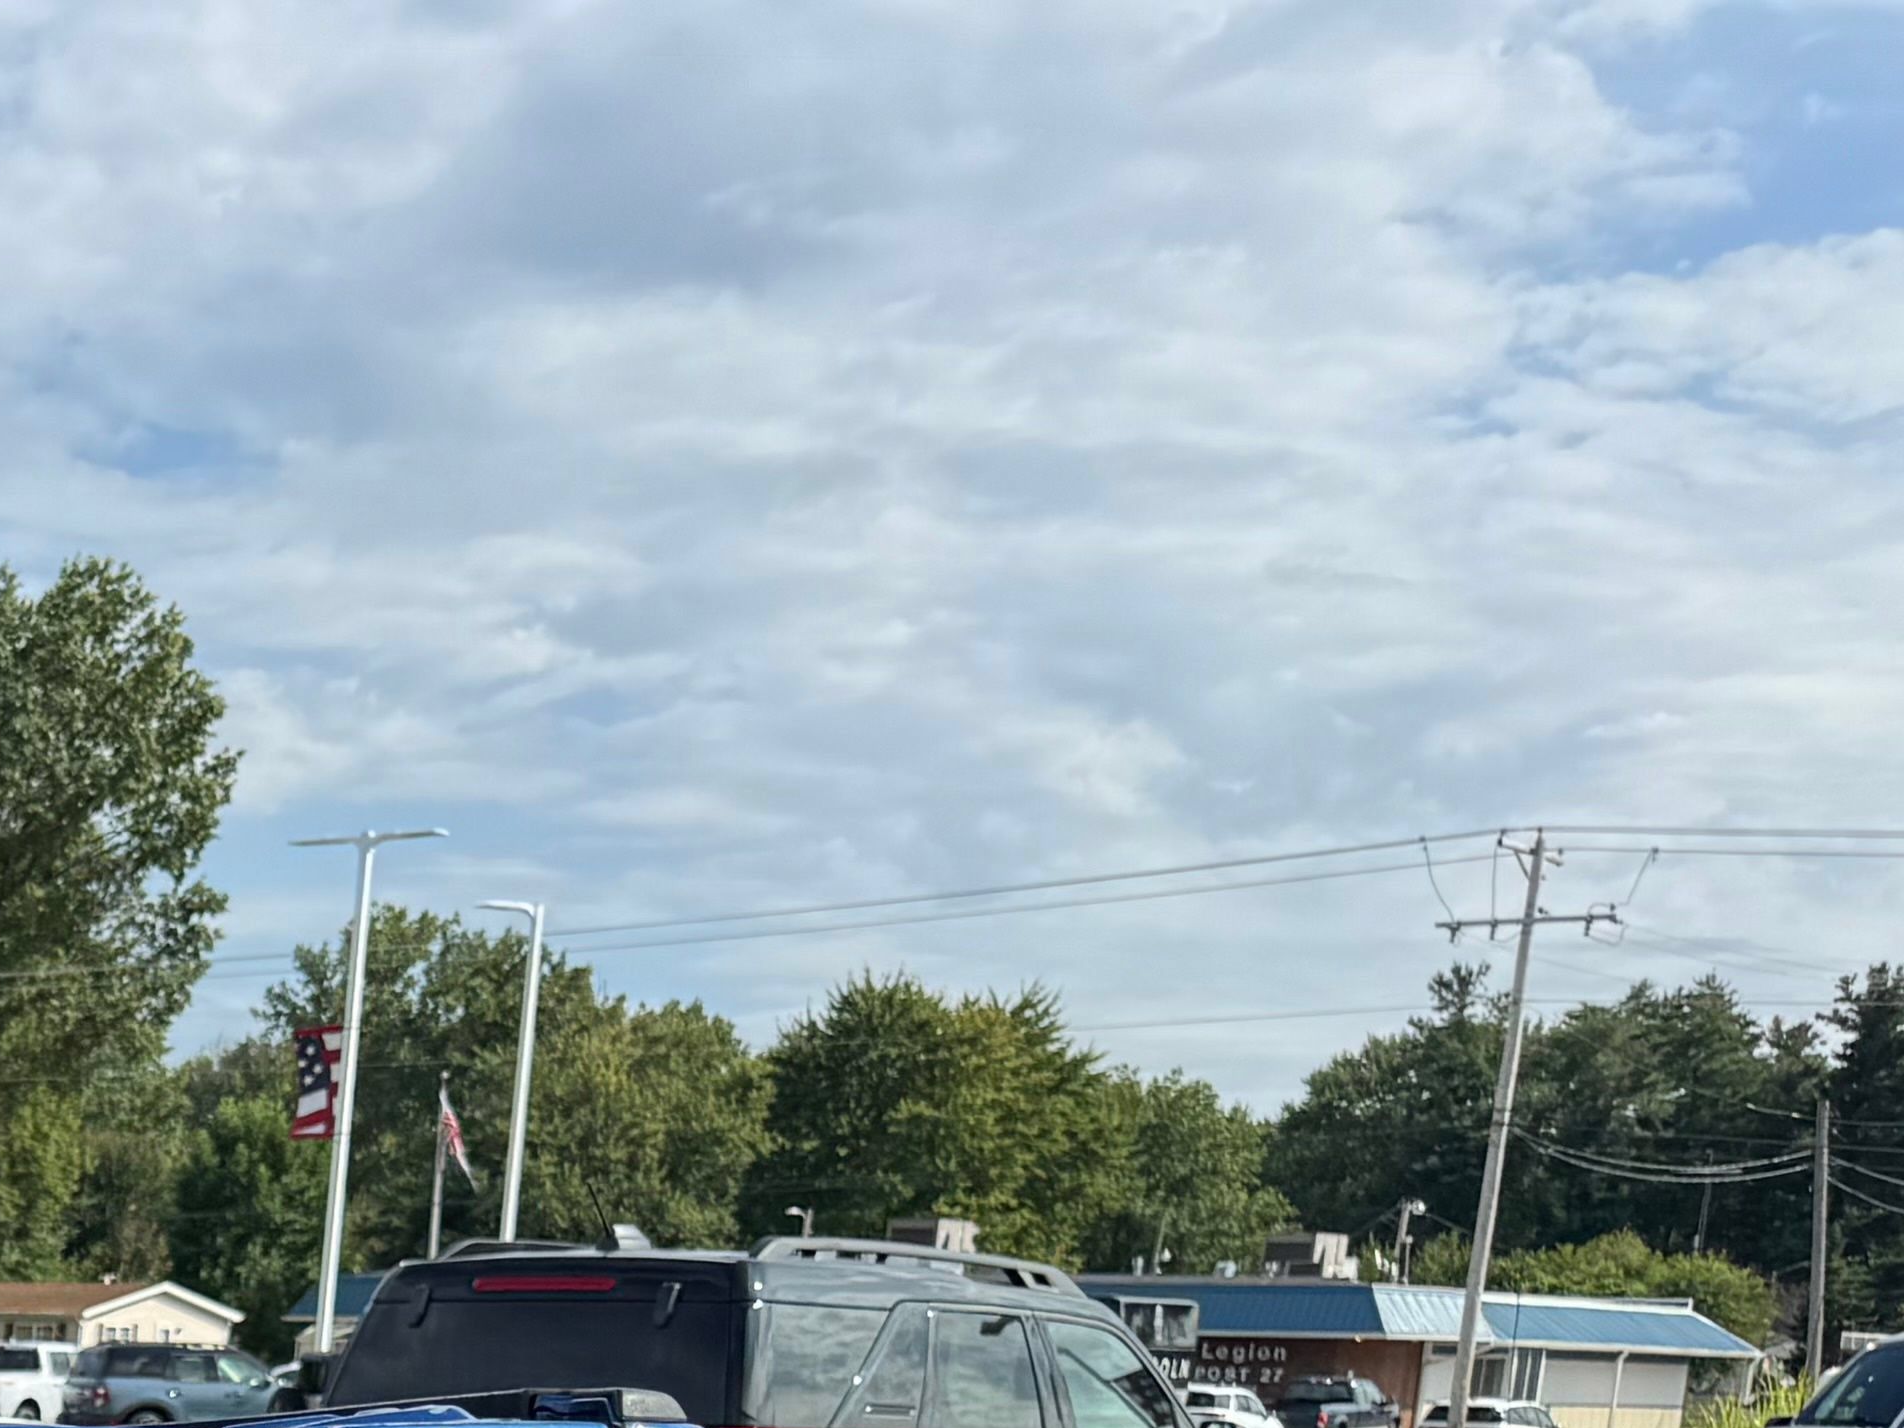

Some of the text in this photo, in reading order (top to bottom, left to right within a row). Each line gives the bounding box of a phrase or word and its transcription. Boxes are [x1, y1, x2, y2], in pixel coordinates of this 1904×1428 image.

[1201, 1342, 1287, 1364] Legion
[1194, 1365, 1285, 1383] POST 27
